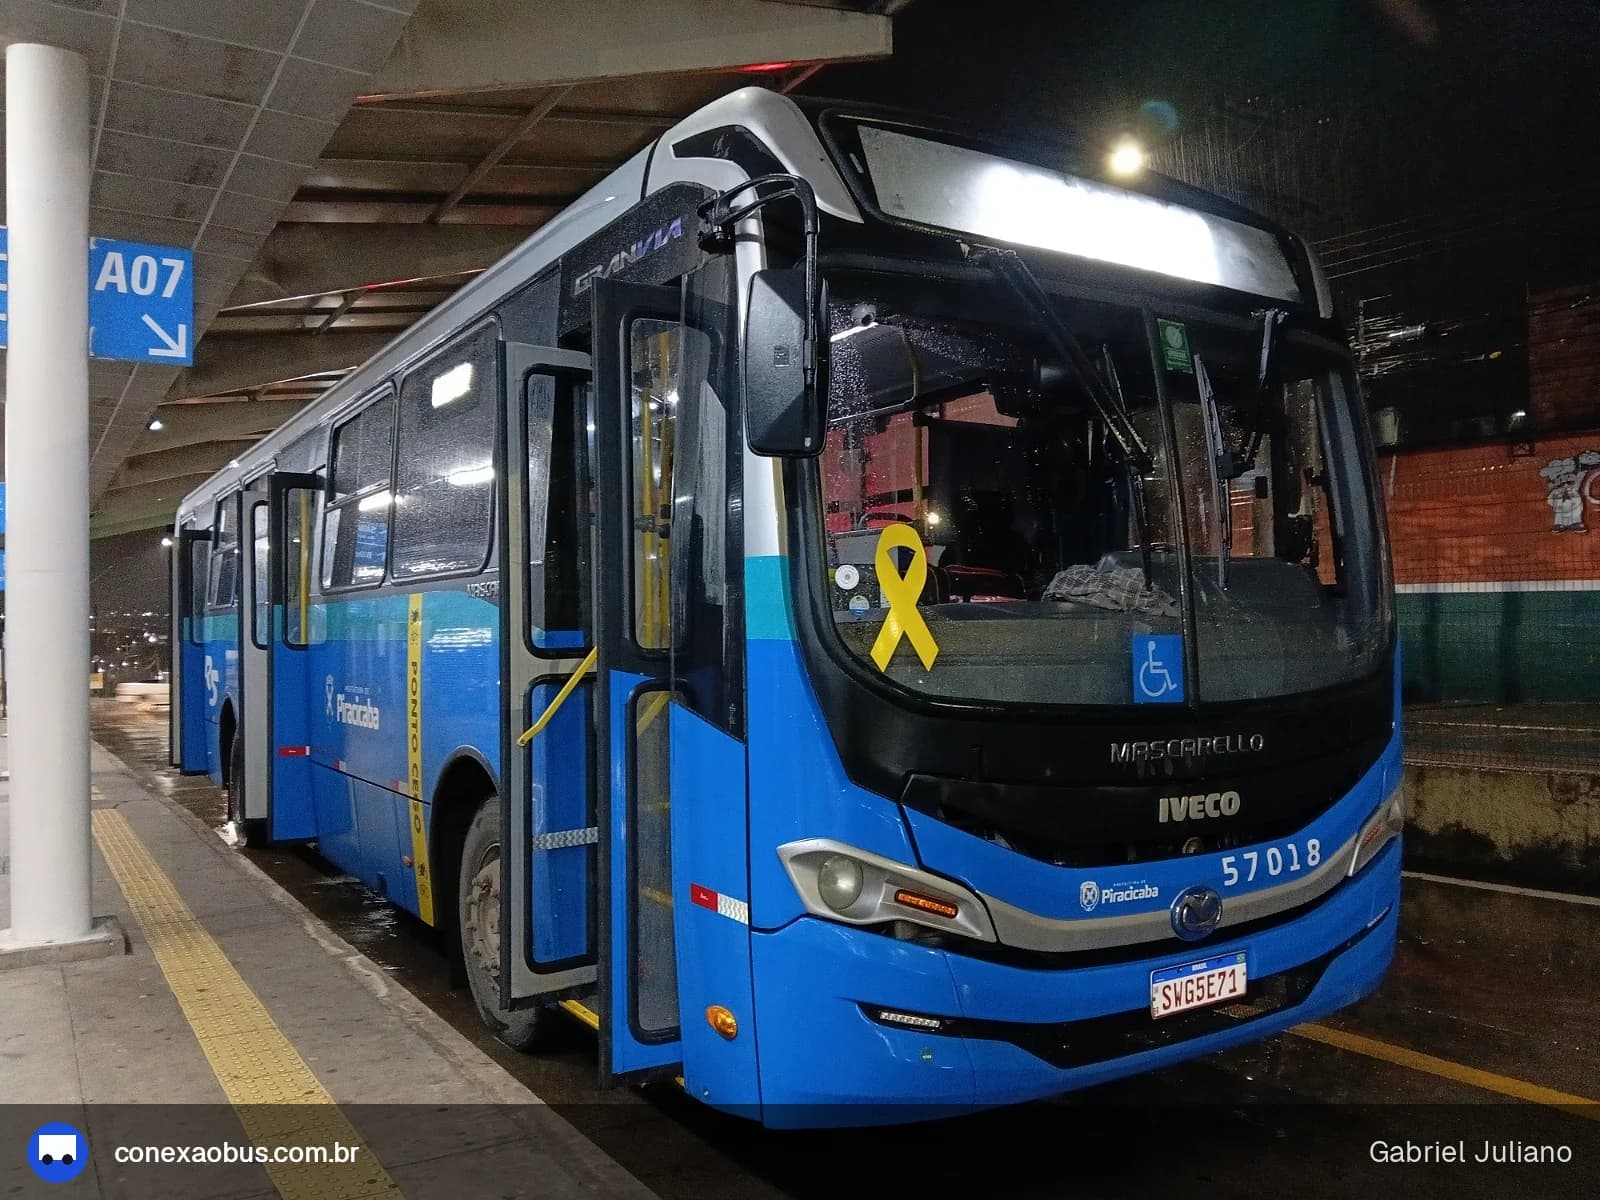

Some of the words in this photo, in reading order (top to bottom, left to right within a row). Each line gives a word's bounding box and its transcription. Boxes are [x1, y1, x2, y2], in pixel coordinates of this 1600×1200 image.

[94, 251, 185, 298] A07
[336, 693, 380, 730] Piracicaba
[411, 661, 420, 752] PONTO
[1110, 733, 1264, 763] MASCARELLO
[1158, 791, 1241, 823] IVECO
[1222, 838, 1320, 886] 57018
[1101, 884, 1159, 904] Piracicaba
[1162, 968, 1237, 1011] SWG5E71
